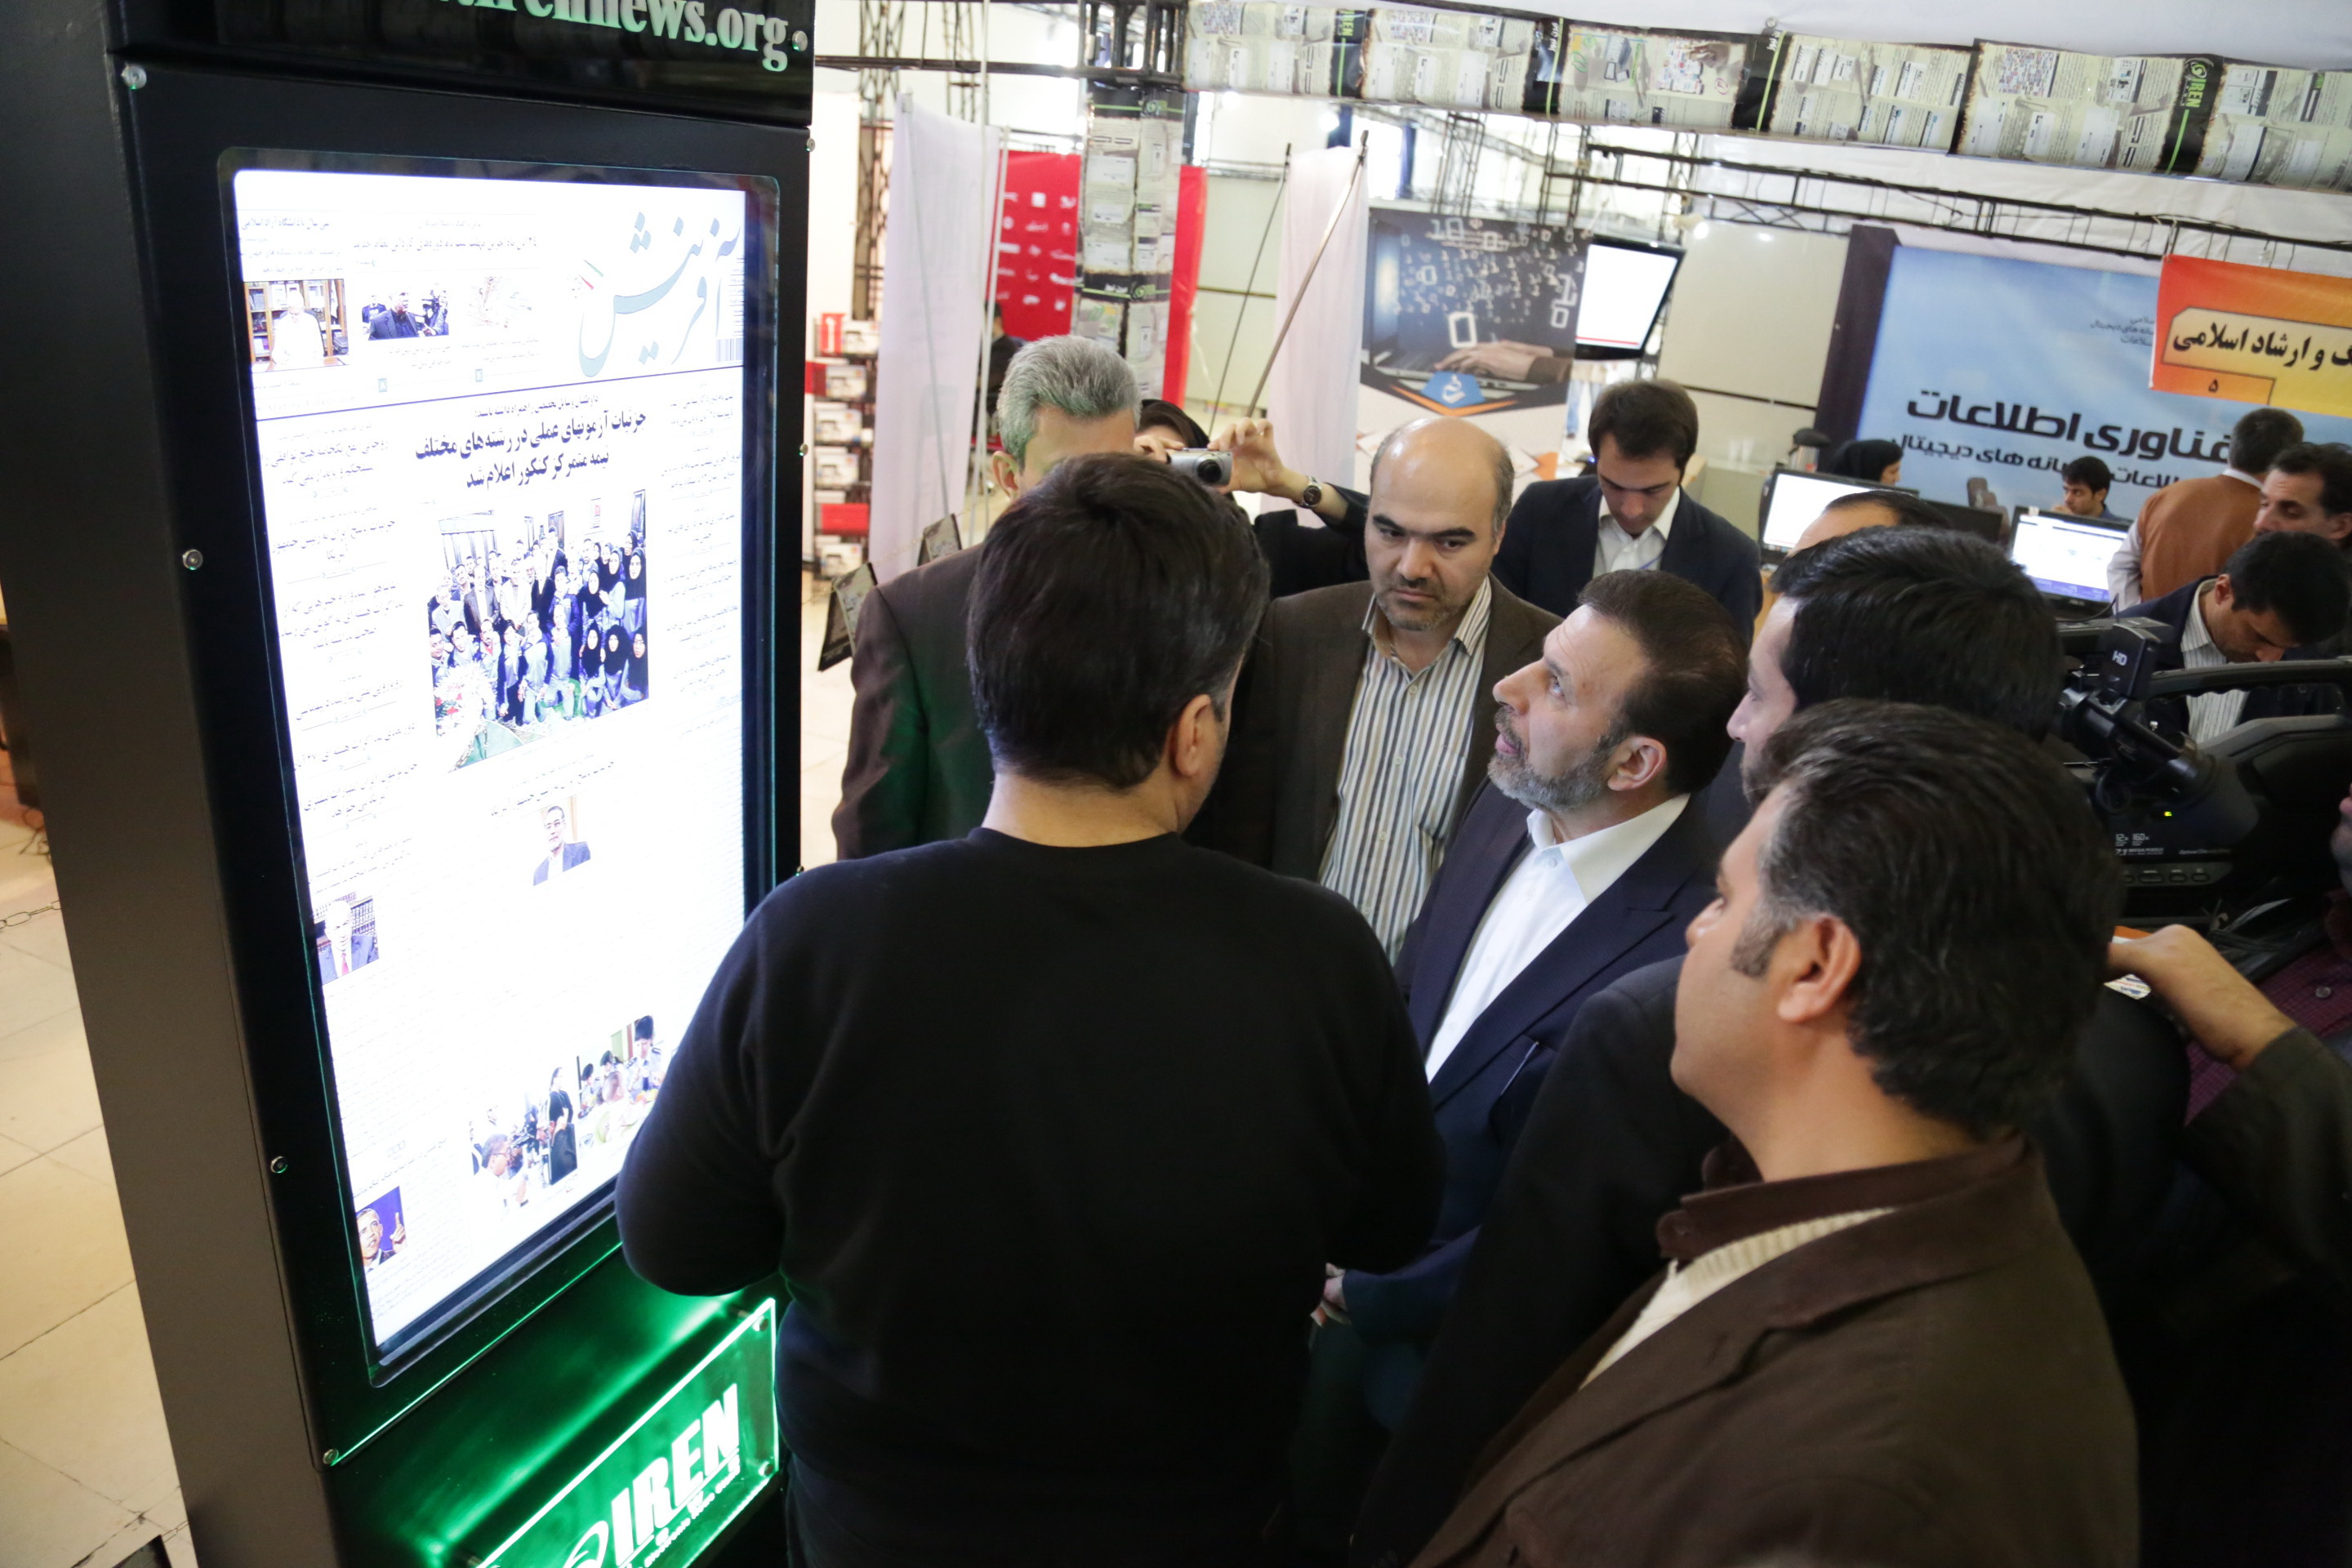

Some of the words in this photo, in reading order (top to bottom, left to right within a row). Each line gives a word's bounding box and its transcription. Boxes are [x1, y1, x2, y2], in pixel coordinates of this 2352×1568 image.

[2185, 78, 2207, 108] IREN
[2172, 321, 2250, 352] اسلامی
[2251, 331, 2311, 368] ارشاد
[2310, 349, 2325, 372] و
[611, 407, 647, 434] جزئیات
[1907, 390, 2082, 441] اطلاعات
[416, 434, 458, 460] مختلف
[514, 428, 528, 452] در
[530, 421, 559, 448] عملی
[2083, 422, 2231, 464] فناوری
[590, 445, 609, 469] نیمه
[1976, 445, 2025, 466] های
[466, 466, 485, 488] شد
[486, 461, 515, 491] اعلام
[517, 454, 550, 487] کنکور
[2112, 650, 2127, 666] HD
[611, 1383, 740, 1567] IREN
